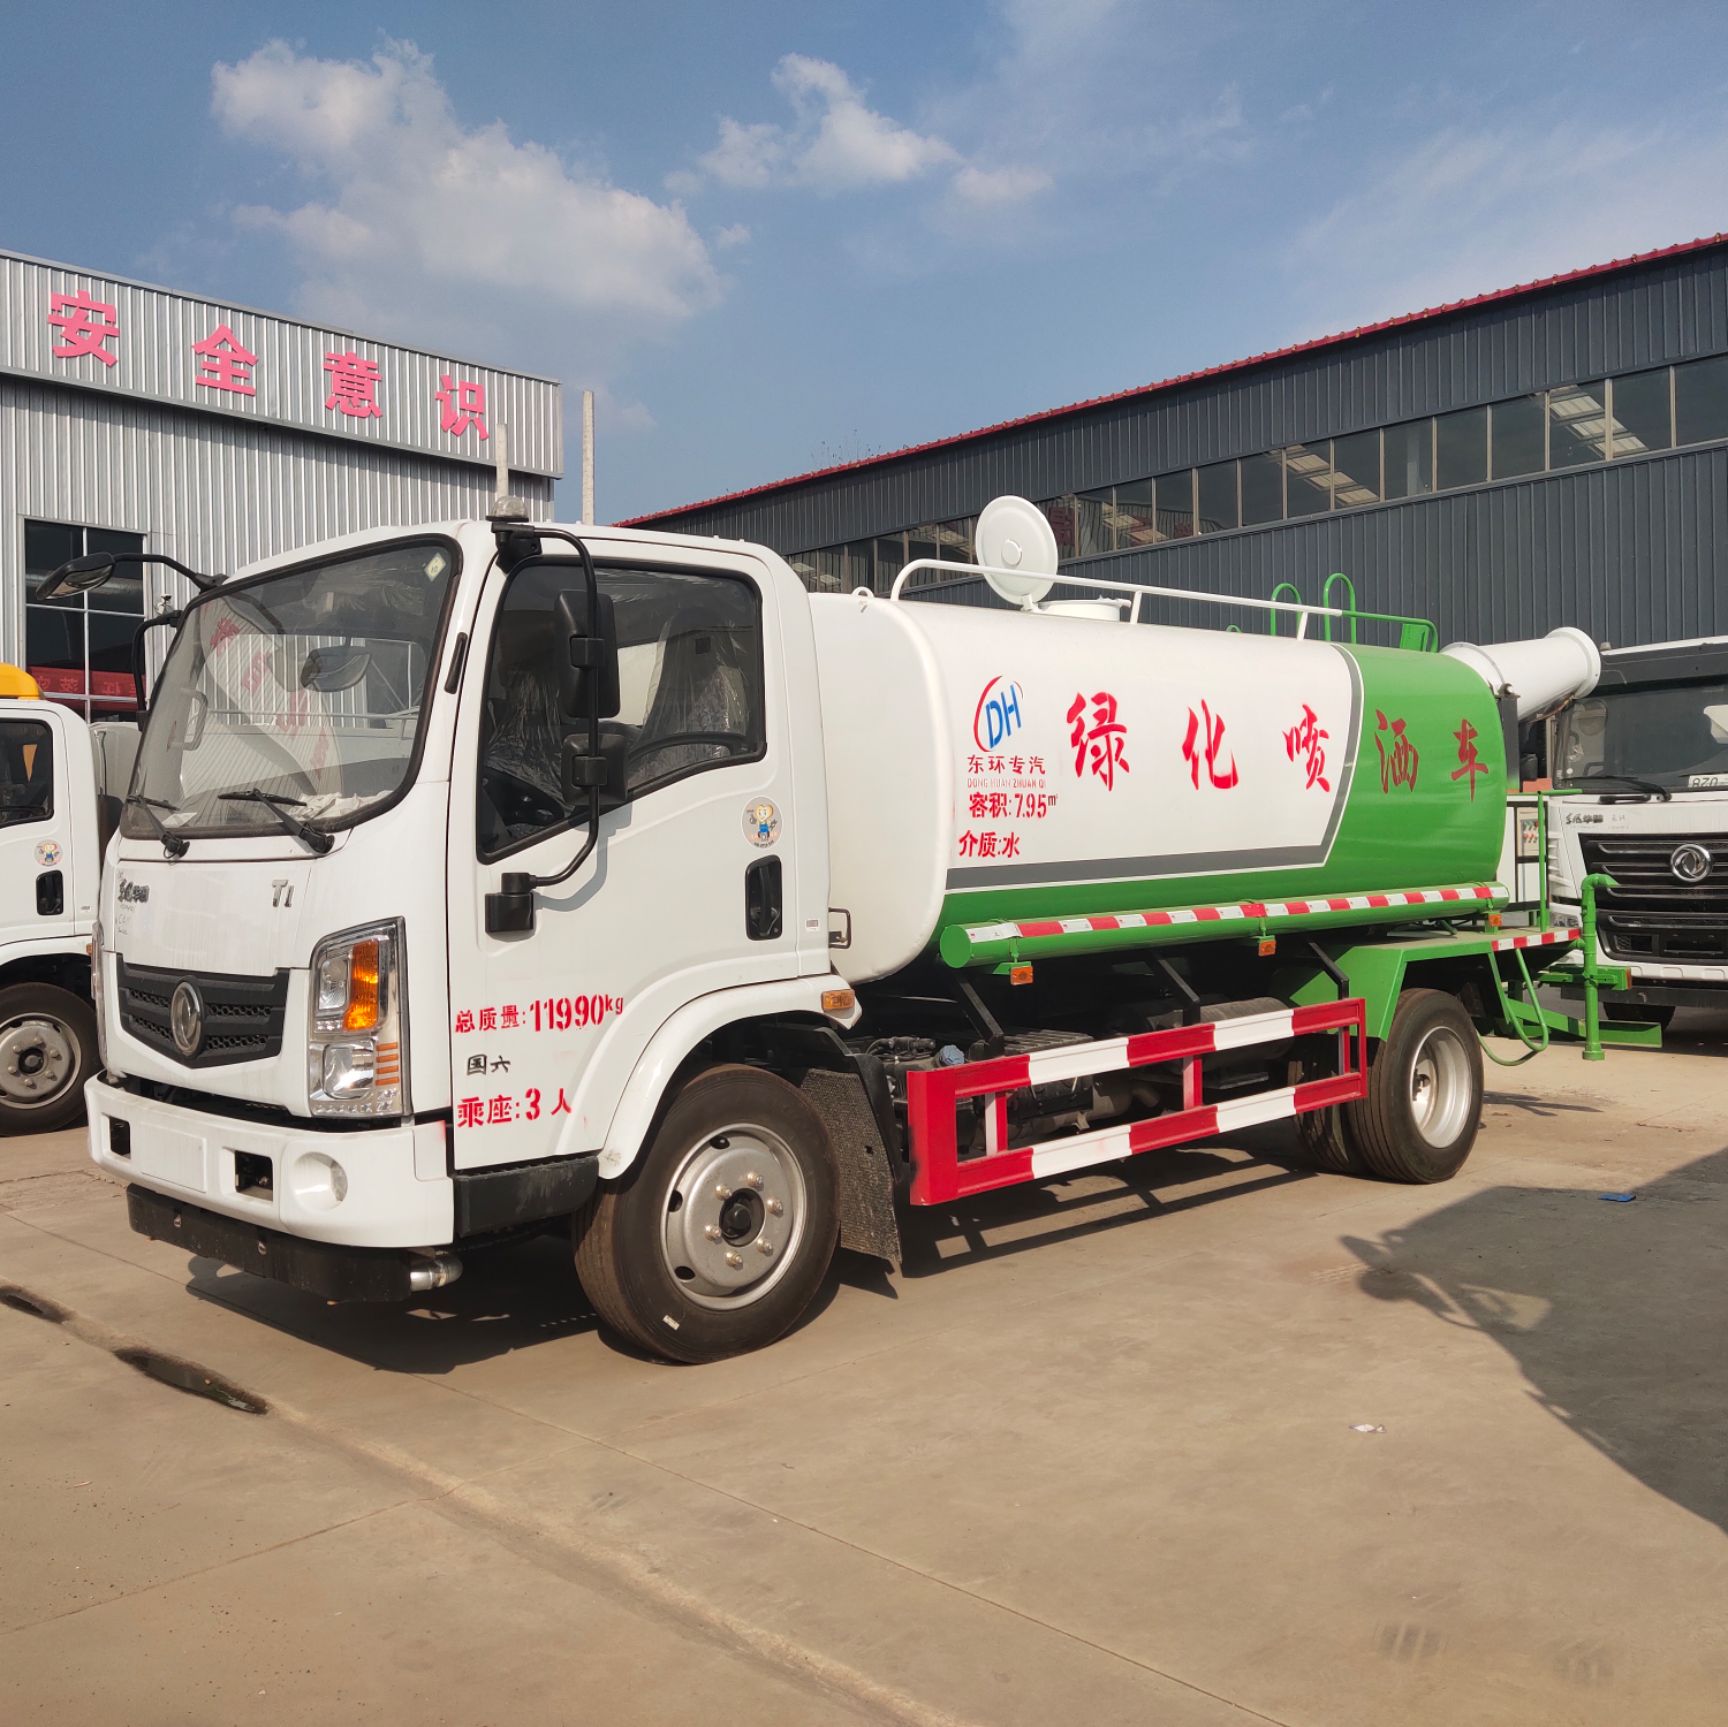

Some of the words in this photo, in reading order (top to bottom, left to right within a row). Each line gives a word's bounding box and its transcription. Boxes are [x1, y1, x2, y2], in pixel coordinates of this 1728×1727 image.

[47, 289, 489, 440] 安全意识
[985, 683, 1022, 749] DH
[967, 754, 1046, 775] 东环专汽
[1066, 690, 1489, 803] 绿化喷洒车
[958, 829, 1021, 859] 介质:水
[466, 1053, 512, 1076] 国六
